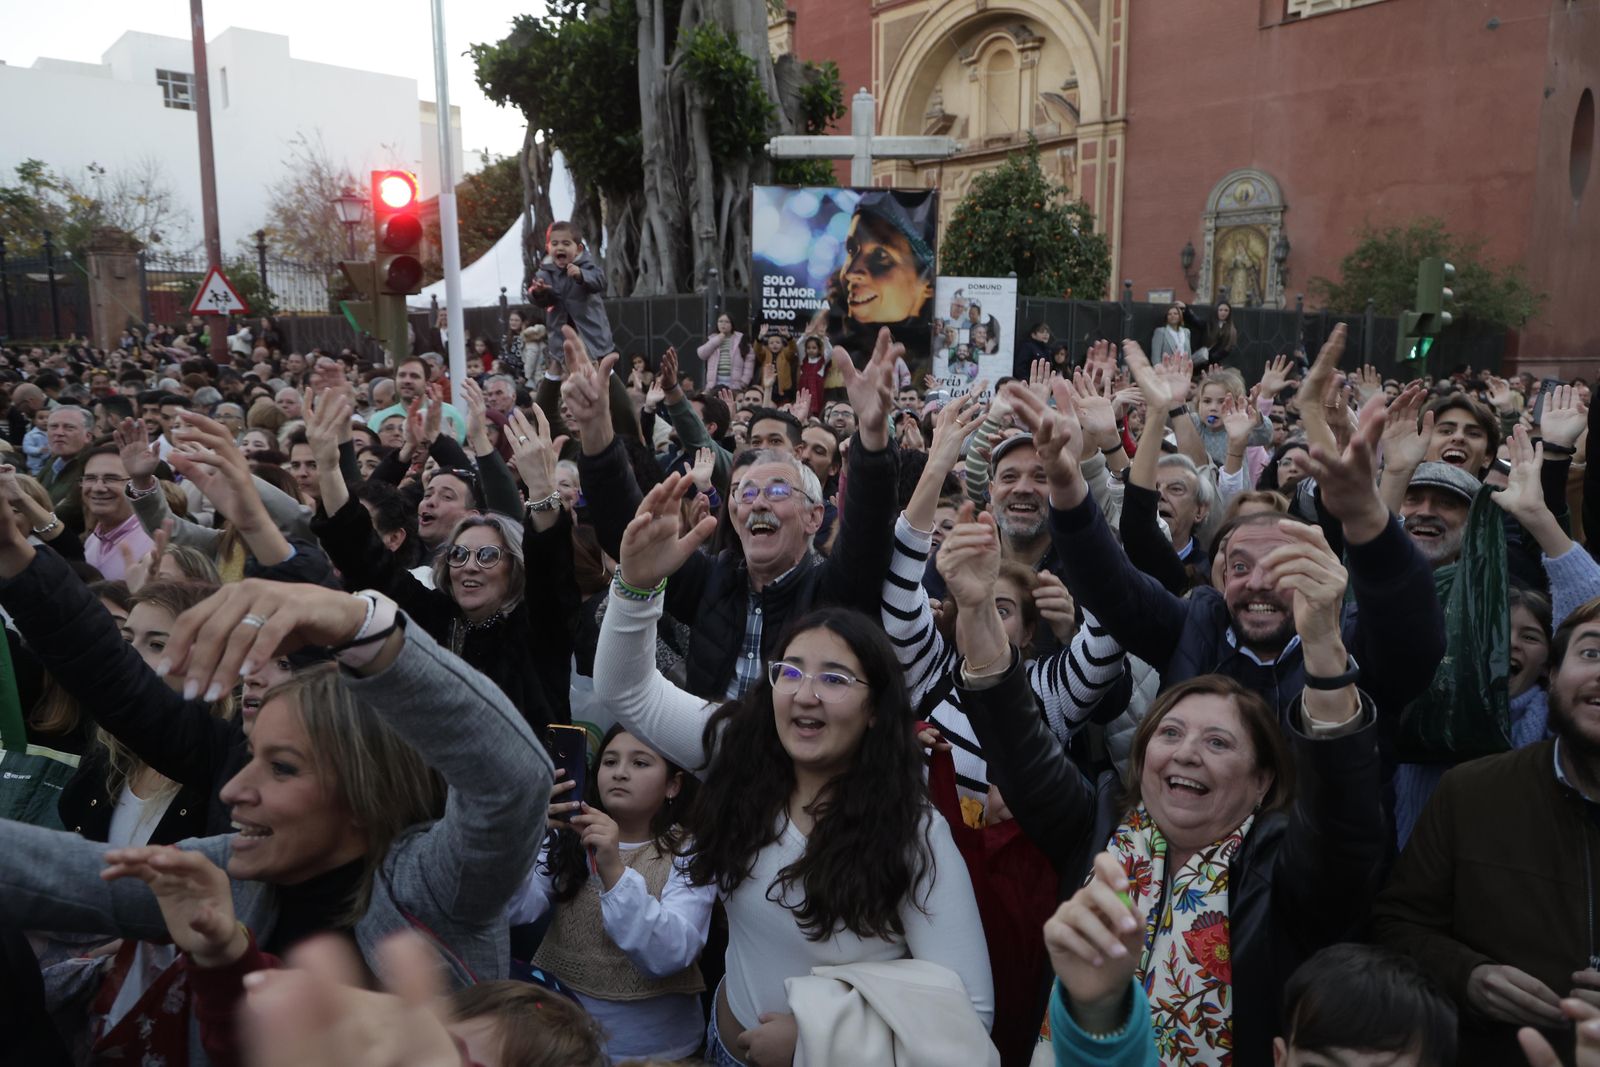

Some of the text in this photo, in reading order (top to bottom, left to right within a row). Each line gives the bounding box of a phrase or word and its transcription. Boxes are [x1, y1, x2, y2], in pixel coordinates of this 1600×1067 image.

[763, 275, 795, 286] SOLO
[763, 287, 816, 298] EL AMOR
[762, 298, 830, 310] LO ILUMINA
[762, 309, 796, 320] TODO
[933, 375, 961, 386] eréis
